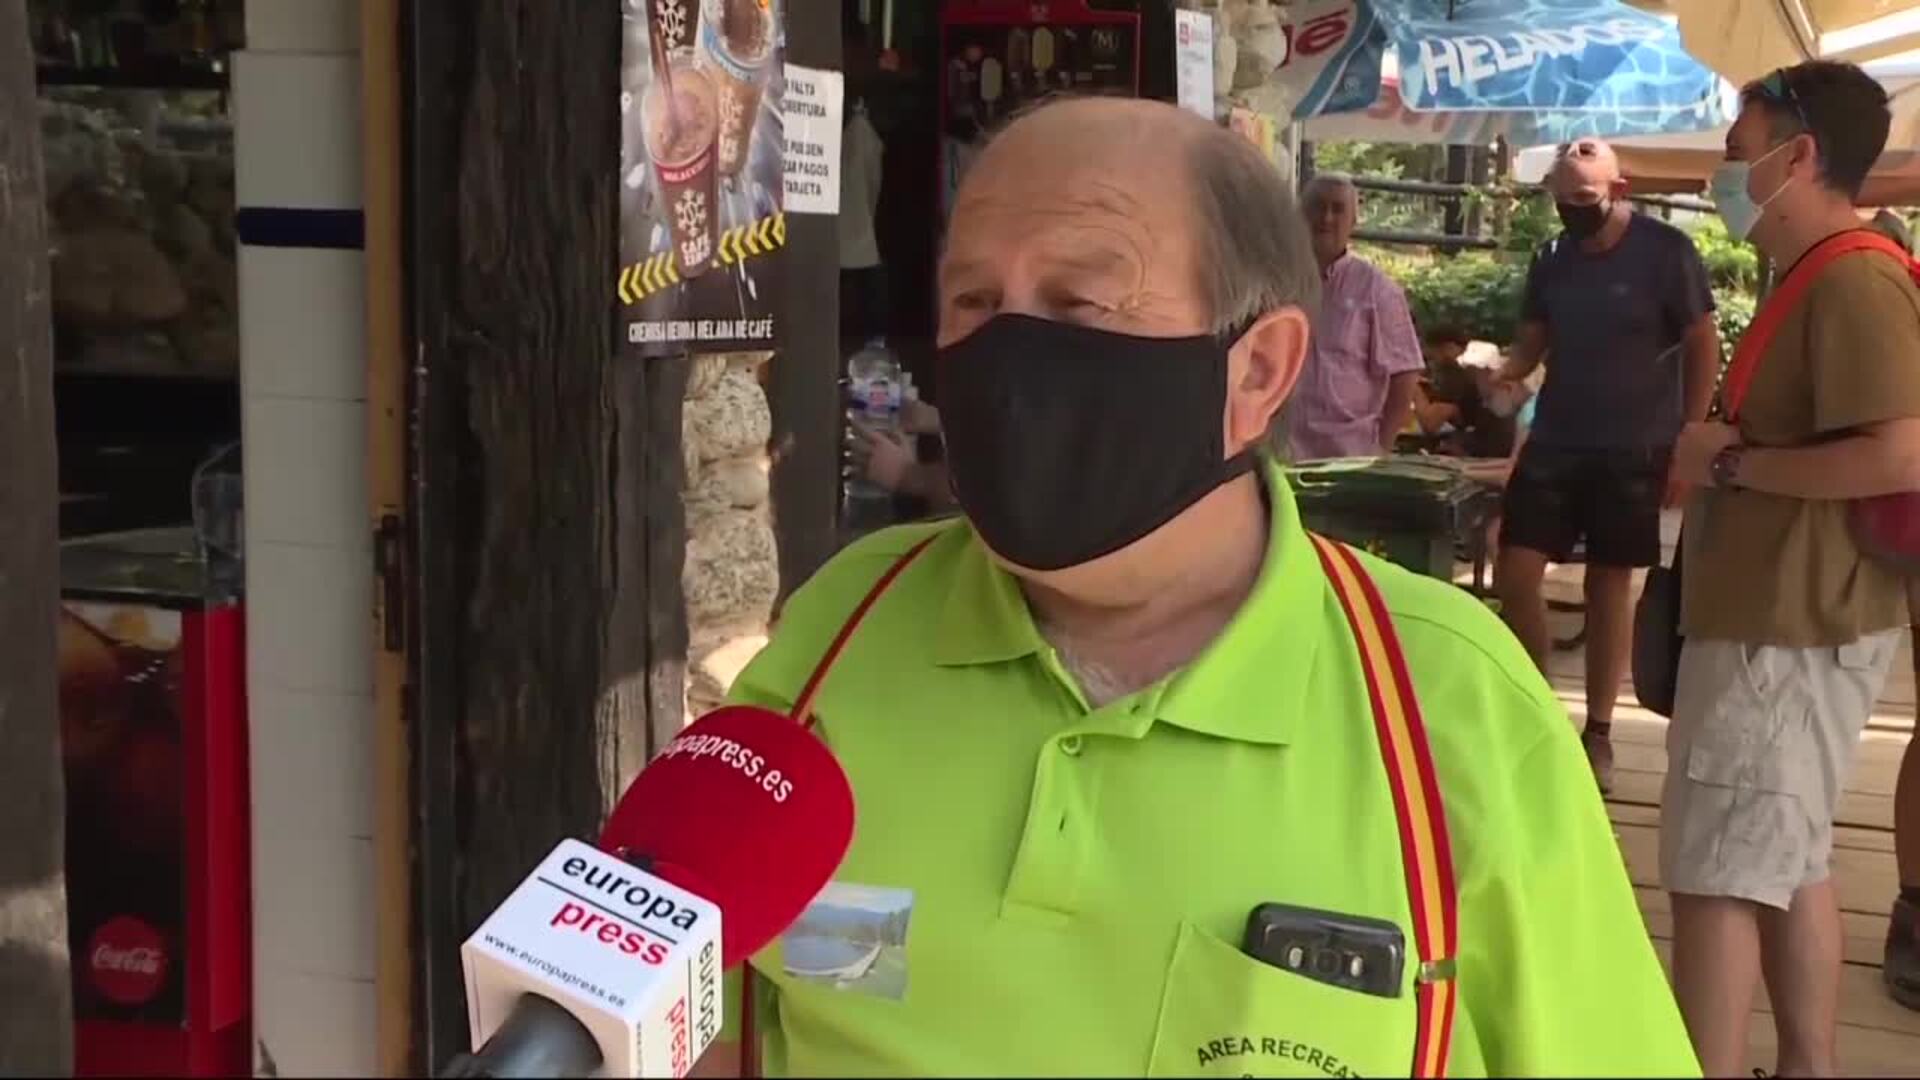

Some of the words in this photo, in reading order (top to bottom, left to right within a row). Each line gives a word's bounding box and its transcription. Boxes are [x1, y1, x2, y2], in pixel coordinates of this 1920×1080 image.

[1418, 20, 1663, 95] HELADOS
[785, 180, 821, 196] TARJETA
[799, 164, 829, 177] PAGOS
[749, 313, 773, 338] CAFÉ
[562, 856, 699, 931] europa
[550, 902, 669, 966] press
[485, 932, 627, 1009] www.europapress.es
[696, 940, 714, 1049] europa
[1197, 1036, 1255, 1067] AREA
